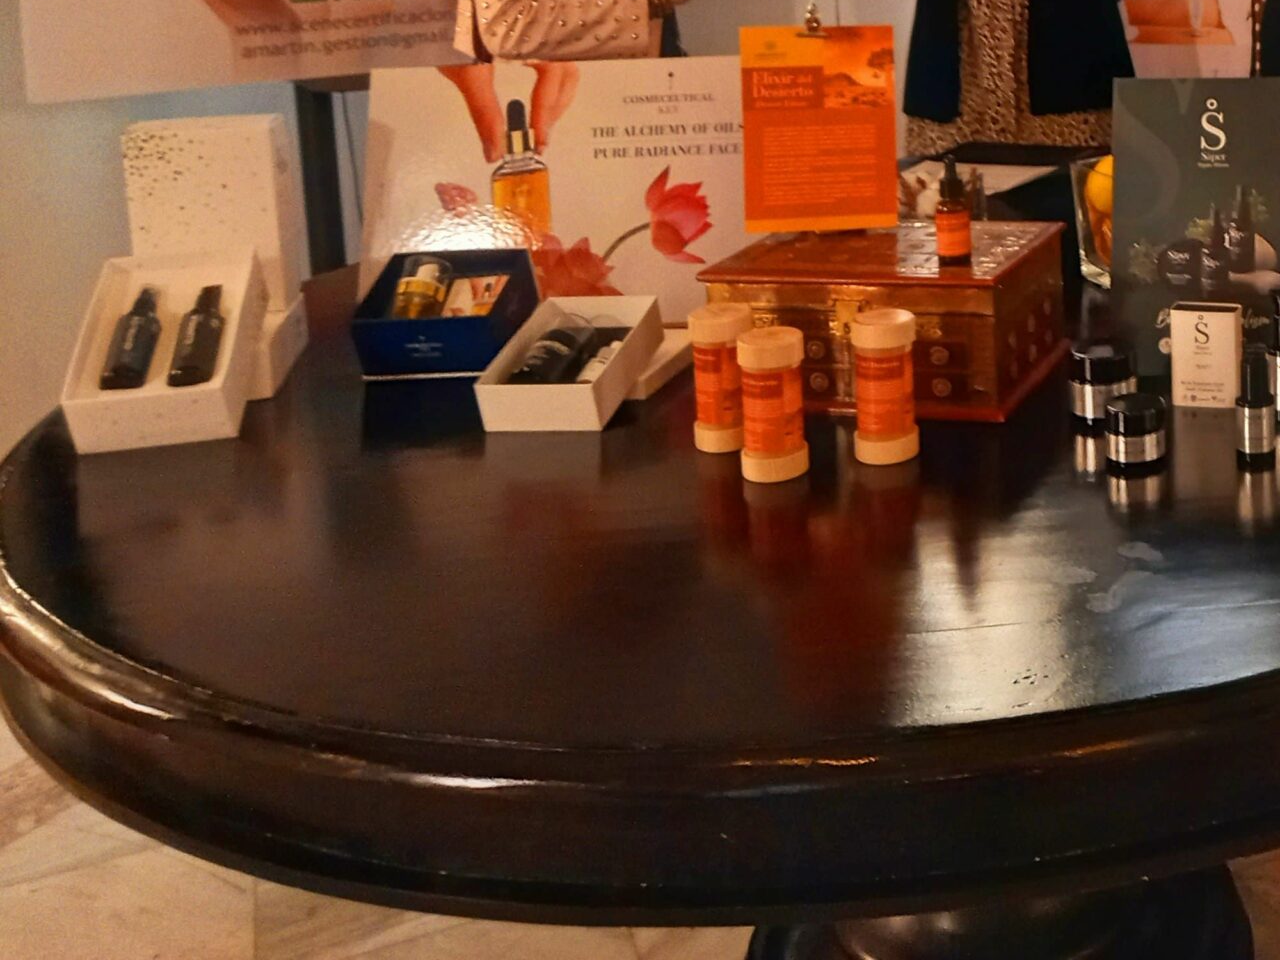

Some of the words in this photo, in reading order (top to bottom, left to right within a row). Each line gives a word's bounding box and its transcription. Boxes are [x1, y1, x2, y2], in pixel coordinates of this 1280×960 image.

[591, 126, 615, 138] THE
[624, 124, 688, 137] ALCHEMY
[692, 122, 708, 134] OF
[593, 147, 627, 159] PURE
[634, 144, 705, 158] RADIANCE
